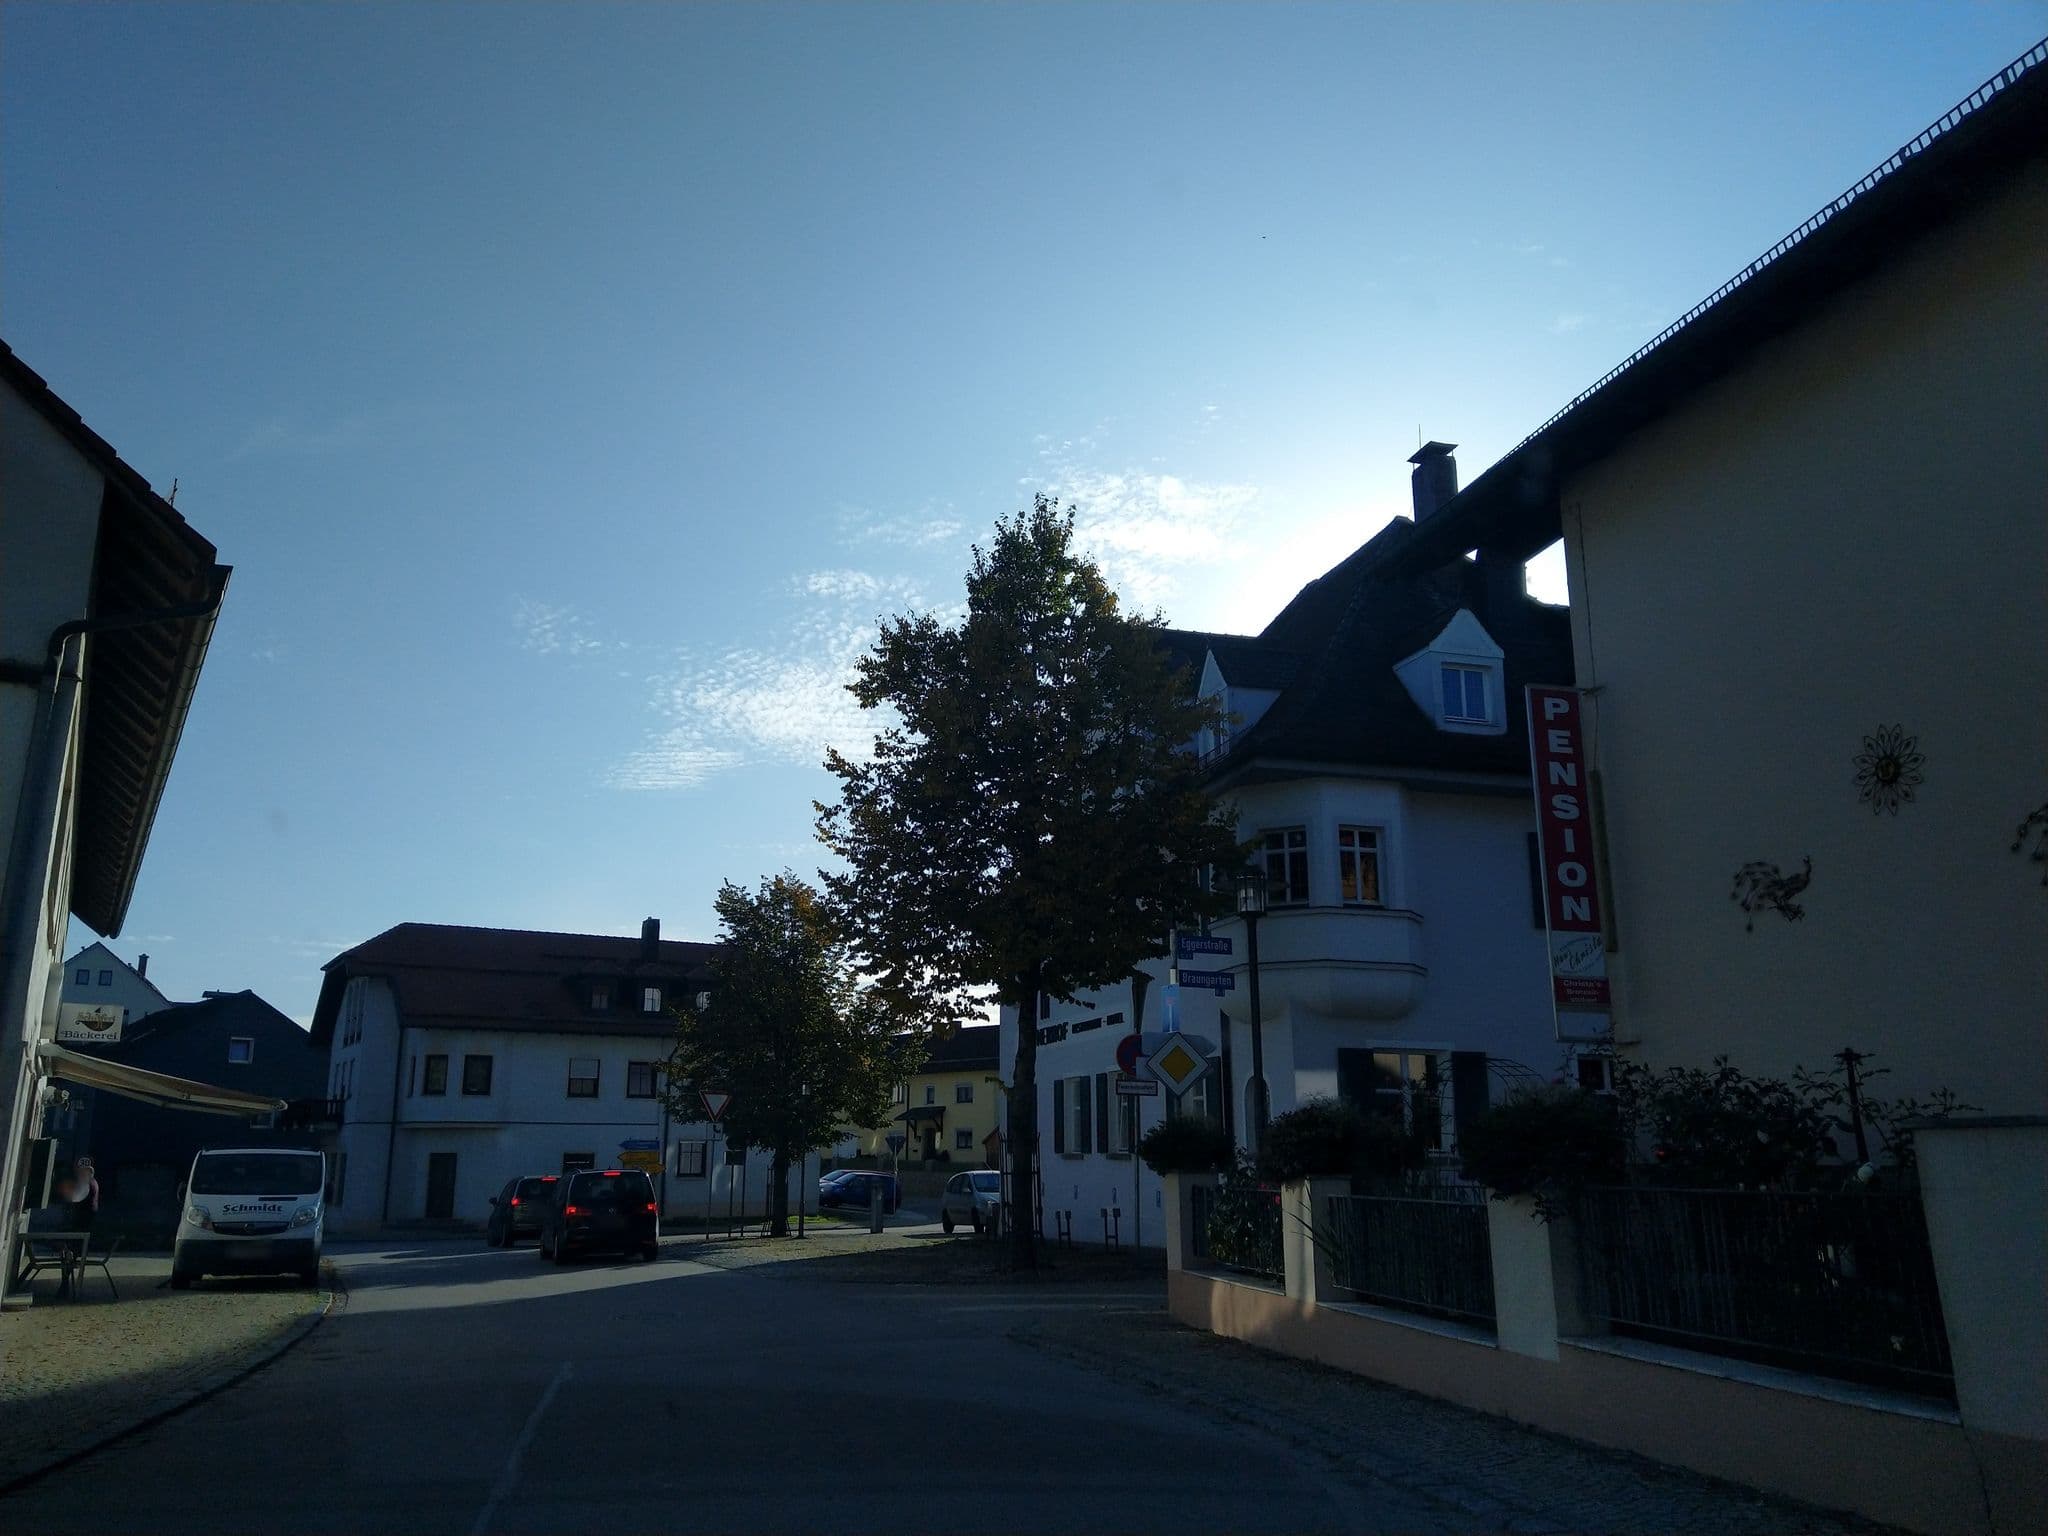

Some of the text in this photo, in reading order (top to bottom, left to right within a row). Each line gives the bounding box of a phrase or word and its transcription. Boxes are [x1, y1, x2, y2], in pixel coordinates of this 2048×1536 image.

[1543, 696, 1592, 922] PENSION
[64, 1030, 117, 1040] Bäckerei
[222, 1203, 283, 1212] Schmidt
